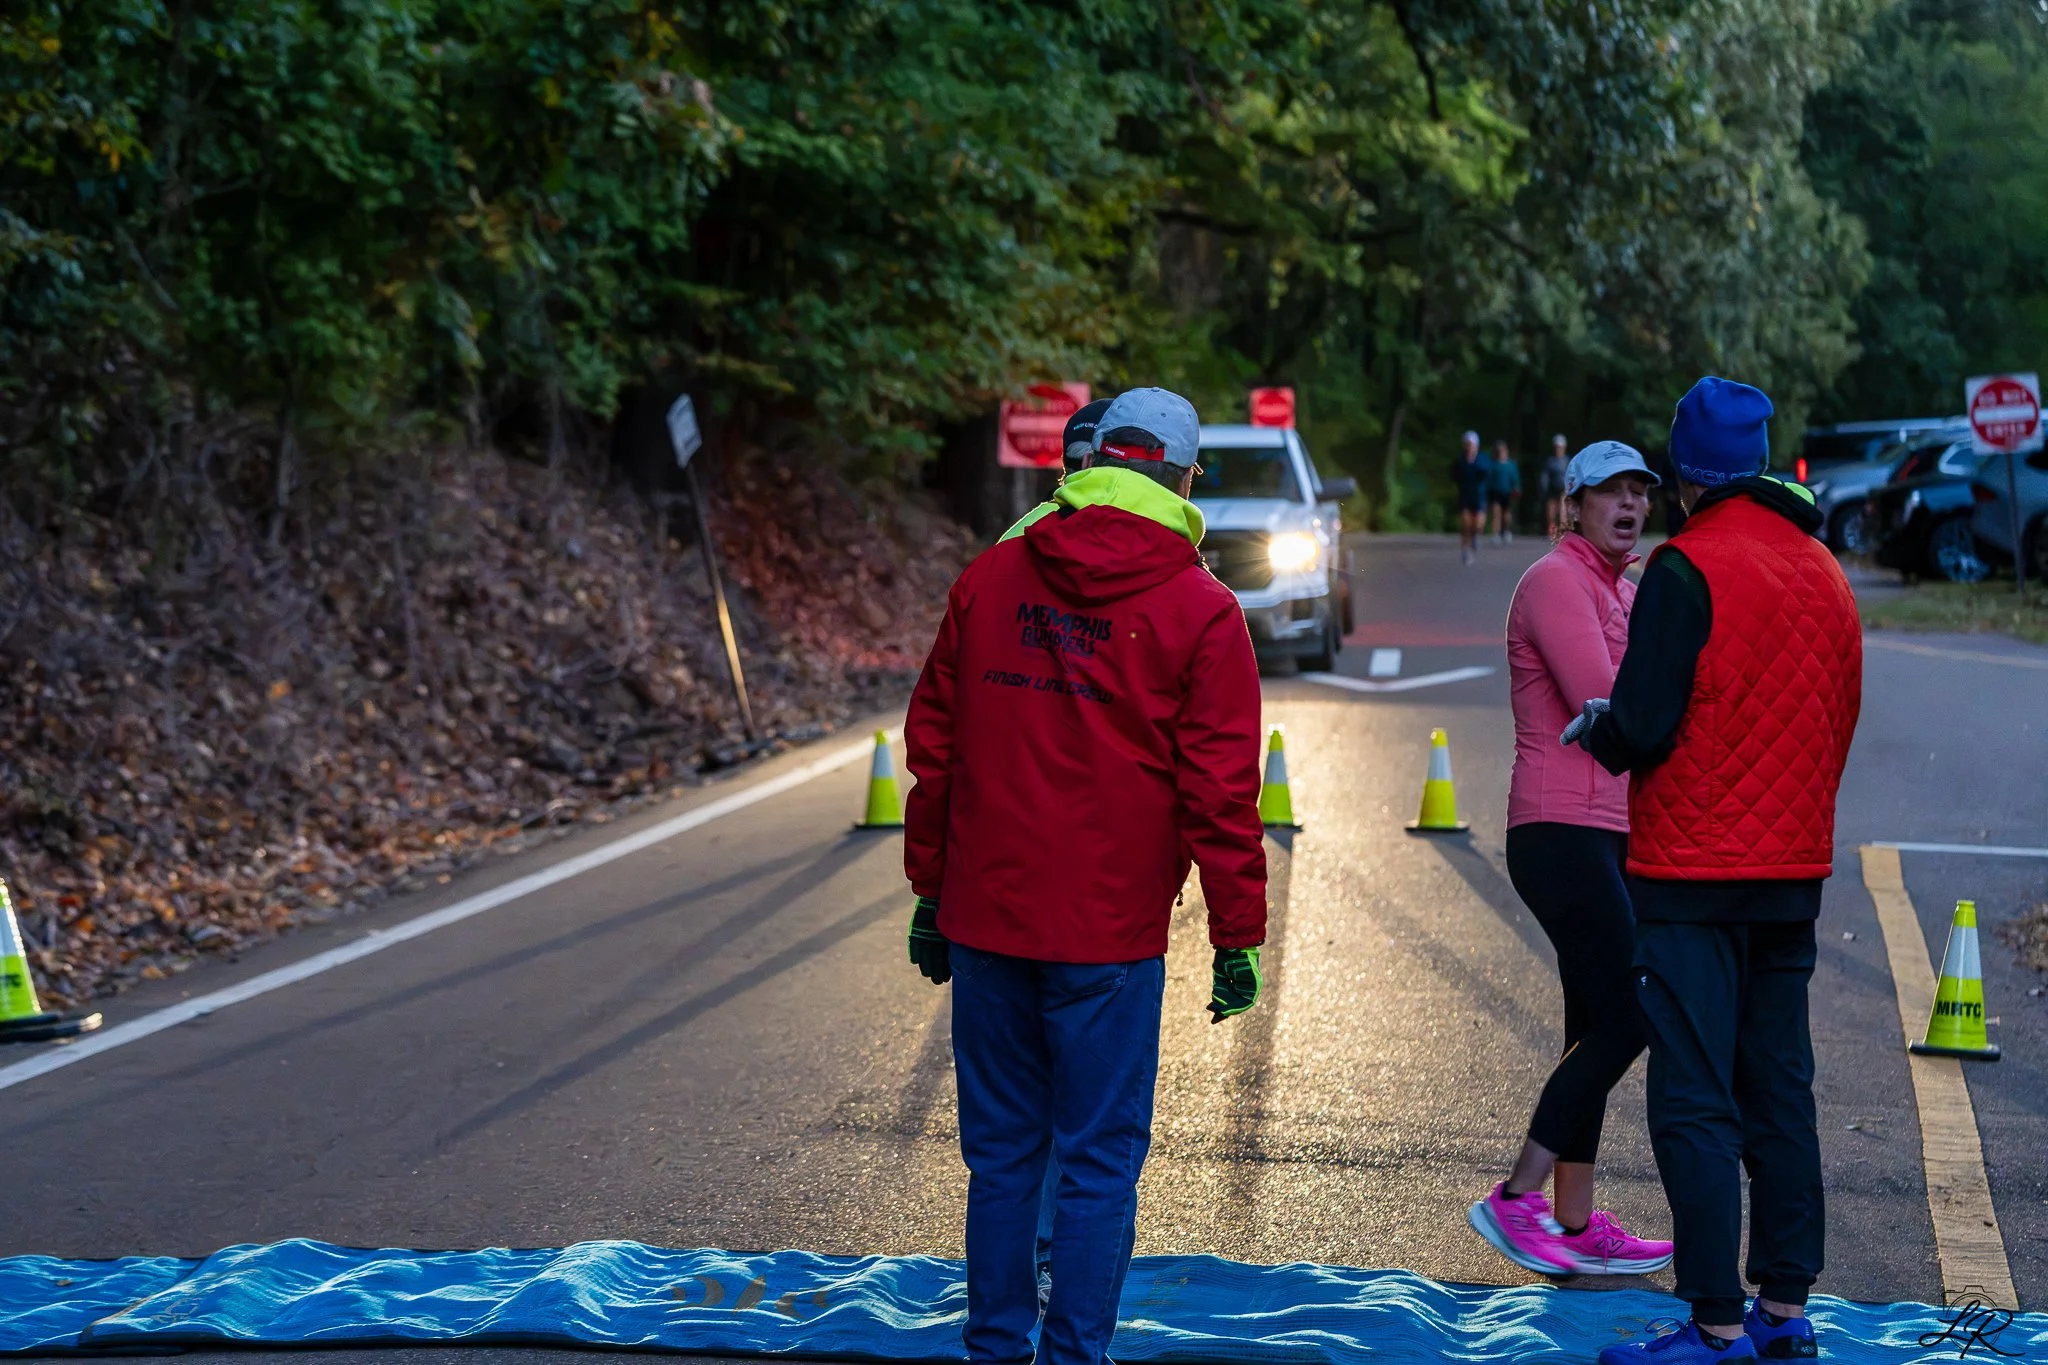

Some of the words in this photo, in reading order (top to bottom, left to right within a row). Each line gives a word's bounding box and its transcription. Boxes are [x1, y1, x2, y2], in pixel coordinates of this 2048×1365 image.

[1016, 602, 1113, 641] MEMPHIS
[1021, 626, 1096, 656] RUNNERS
[982, 669, 1032, 688] FINISH
[1034, 676, 1066, 694] LINE
[1936, 1000, 1981, 1018] MRTC
